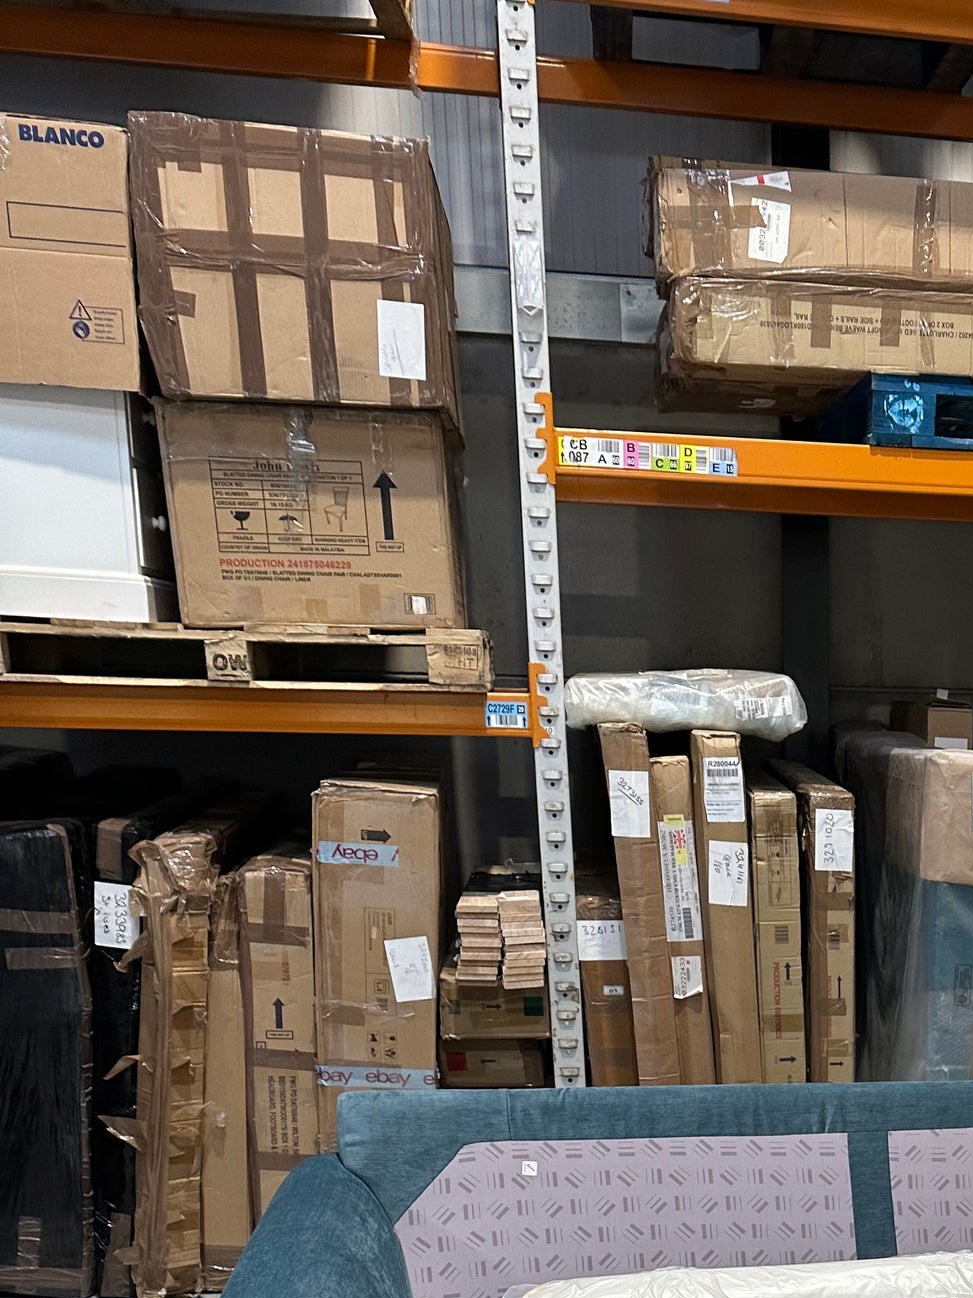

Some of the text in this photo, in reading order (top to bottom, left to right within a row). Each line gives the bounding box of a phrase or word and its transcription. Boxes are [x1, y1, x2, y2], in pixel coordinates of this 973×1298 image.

[18, 123, 105, 148] BLANCO
[570, 439, 588, 450] CB
[626, 443, 635, 452] B
[684, 447, 693, 457] D
[597, 454, 607, 464] A
[655, 459, 664, 468] C
[712, 463, 720, 473] E
[219, 558, 285, 568] PRODUCTION
[488, 704, 515, 714] C2729F
[331, 843, 379, 863] ebay
[365, 1069, 411, 1087] ebay
